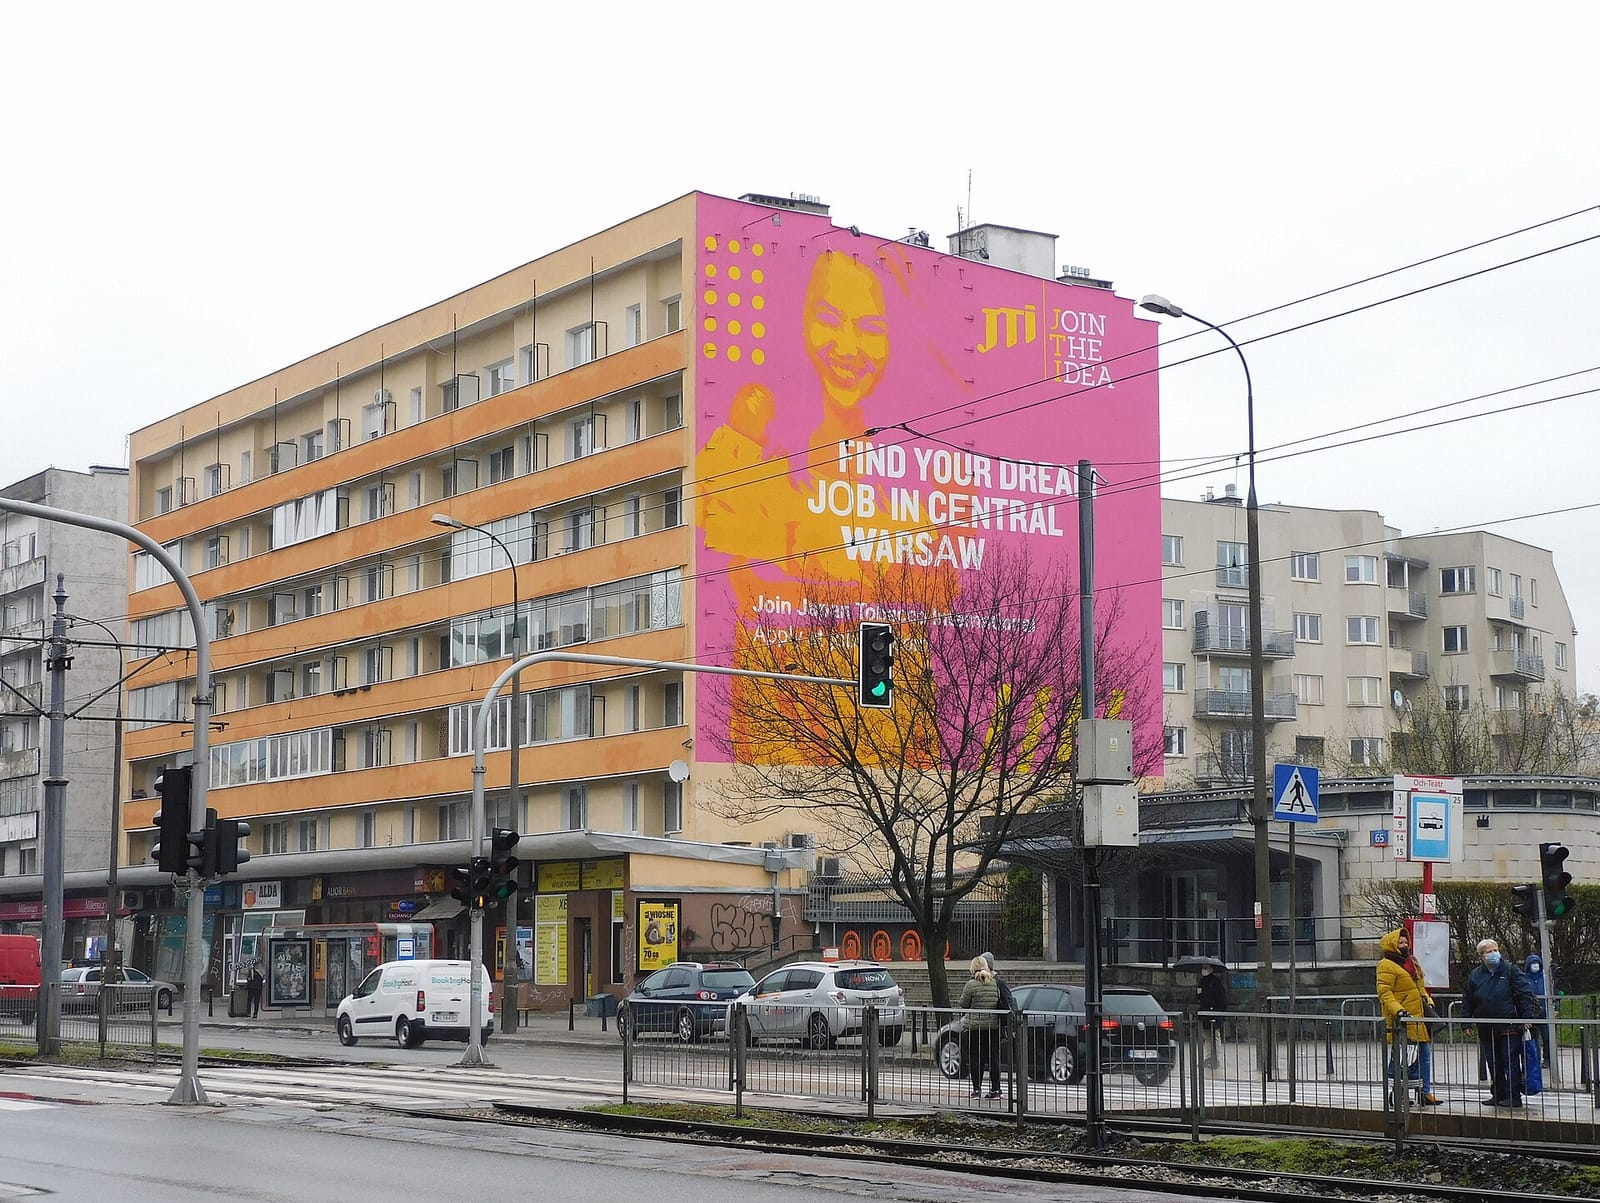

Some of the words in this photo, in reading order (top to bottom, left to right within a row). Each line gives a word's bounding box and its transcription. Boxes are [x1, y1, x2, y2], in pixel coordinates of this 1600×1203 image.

[1050, 308, 1106, 336] JOIN
[1048, 333, 1102, 362] THE
[1054, 359, 1115, 389] IDEA
[838, 439, 906, 478] FIND
[914, 447, 992, 489] YOUR
[807, 479, 876, 518] JOB
[891, 487, 920, 523] IN
[928, 490, 1064, 537] CENTRAL
[840, 525, 986, 571] WARSAW
[753, 594, 792, 615] Join
[1413, 778, 1444, 788] Och-Teatr
[1398, 793, 1402, 801] 1
[1452, 796, 1462, 805] 25
[1397, 806, 1402, 815] 7
[1397, 820, 1402, 829] 9
[1374, 833, 1385, 843] 65
[1396, 834, 1404, 842] 14
[1395, 847, 1404, 857] 15
[258, 884, 278, 898] ALDA
[327, 886, 342, 897] ALIOR
[643, 950, 652, 958] 70
